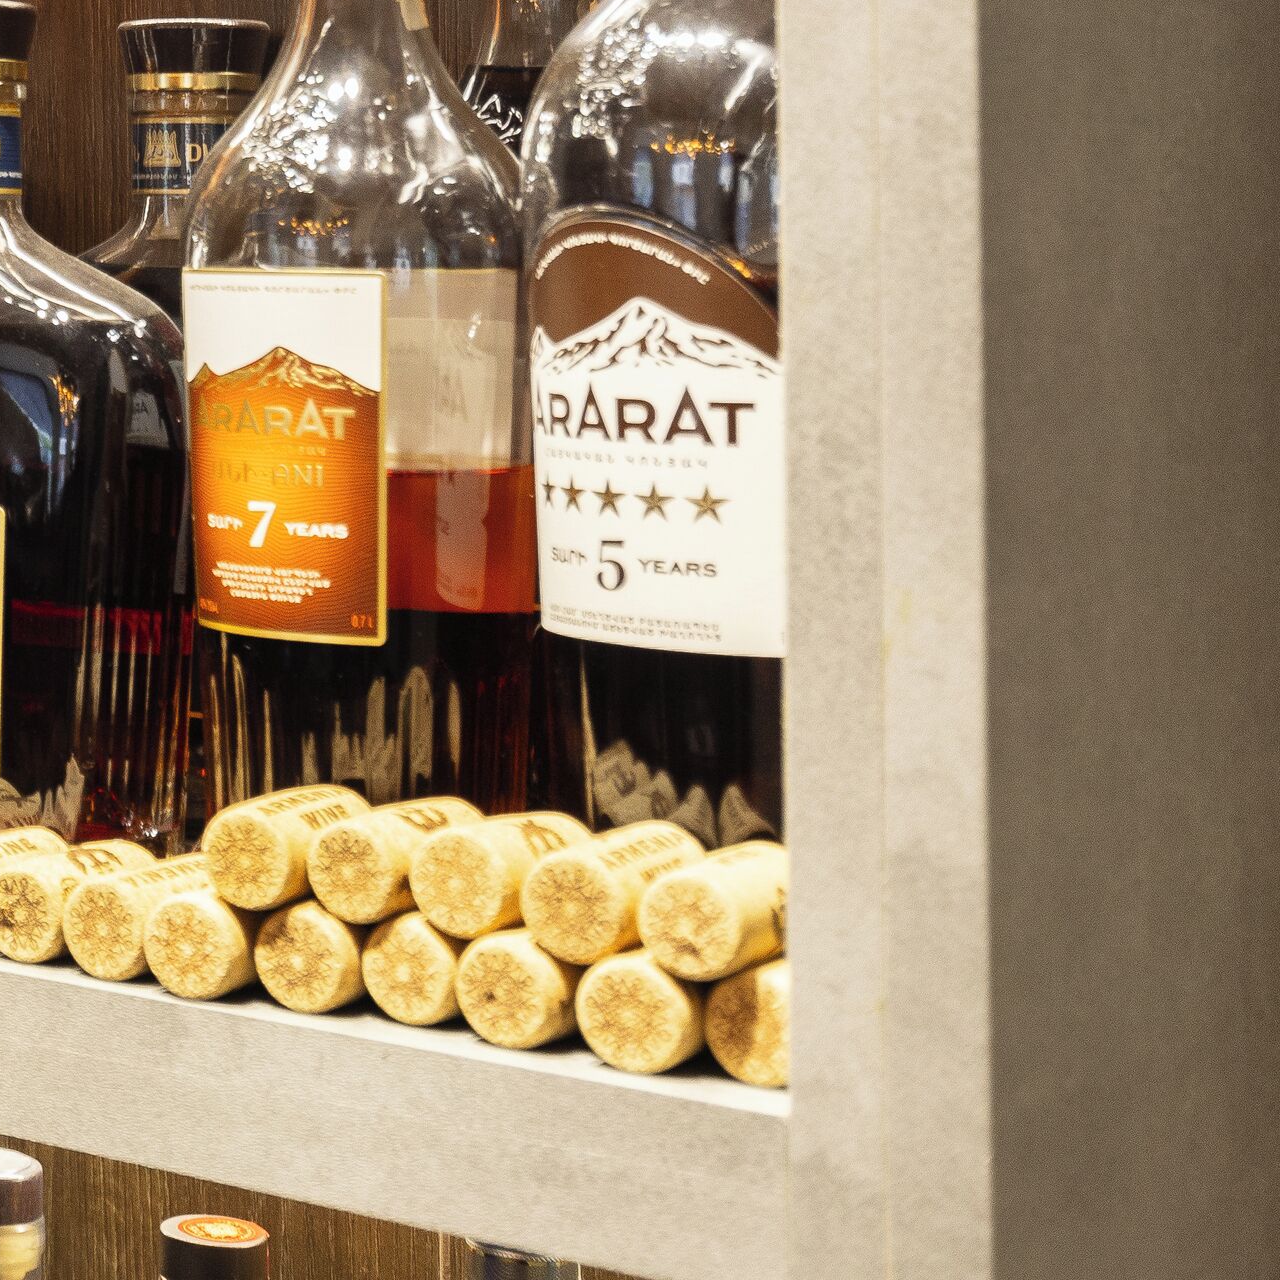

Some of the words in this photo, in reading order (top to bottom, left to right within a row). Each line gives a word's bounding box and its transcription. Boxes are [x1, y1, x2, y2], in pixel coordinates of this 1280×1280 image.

[198, 396, 356, 441] ARARAT
[247, 500, 278, 548] 7
[283, 521, 350, 540] YEARS
[596, 539, 626, 592] 5
[637, 558, 718, 578] YEARS
[299, 805, 349, 831] WINE
